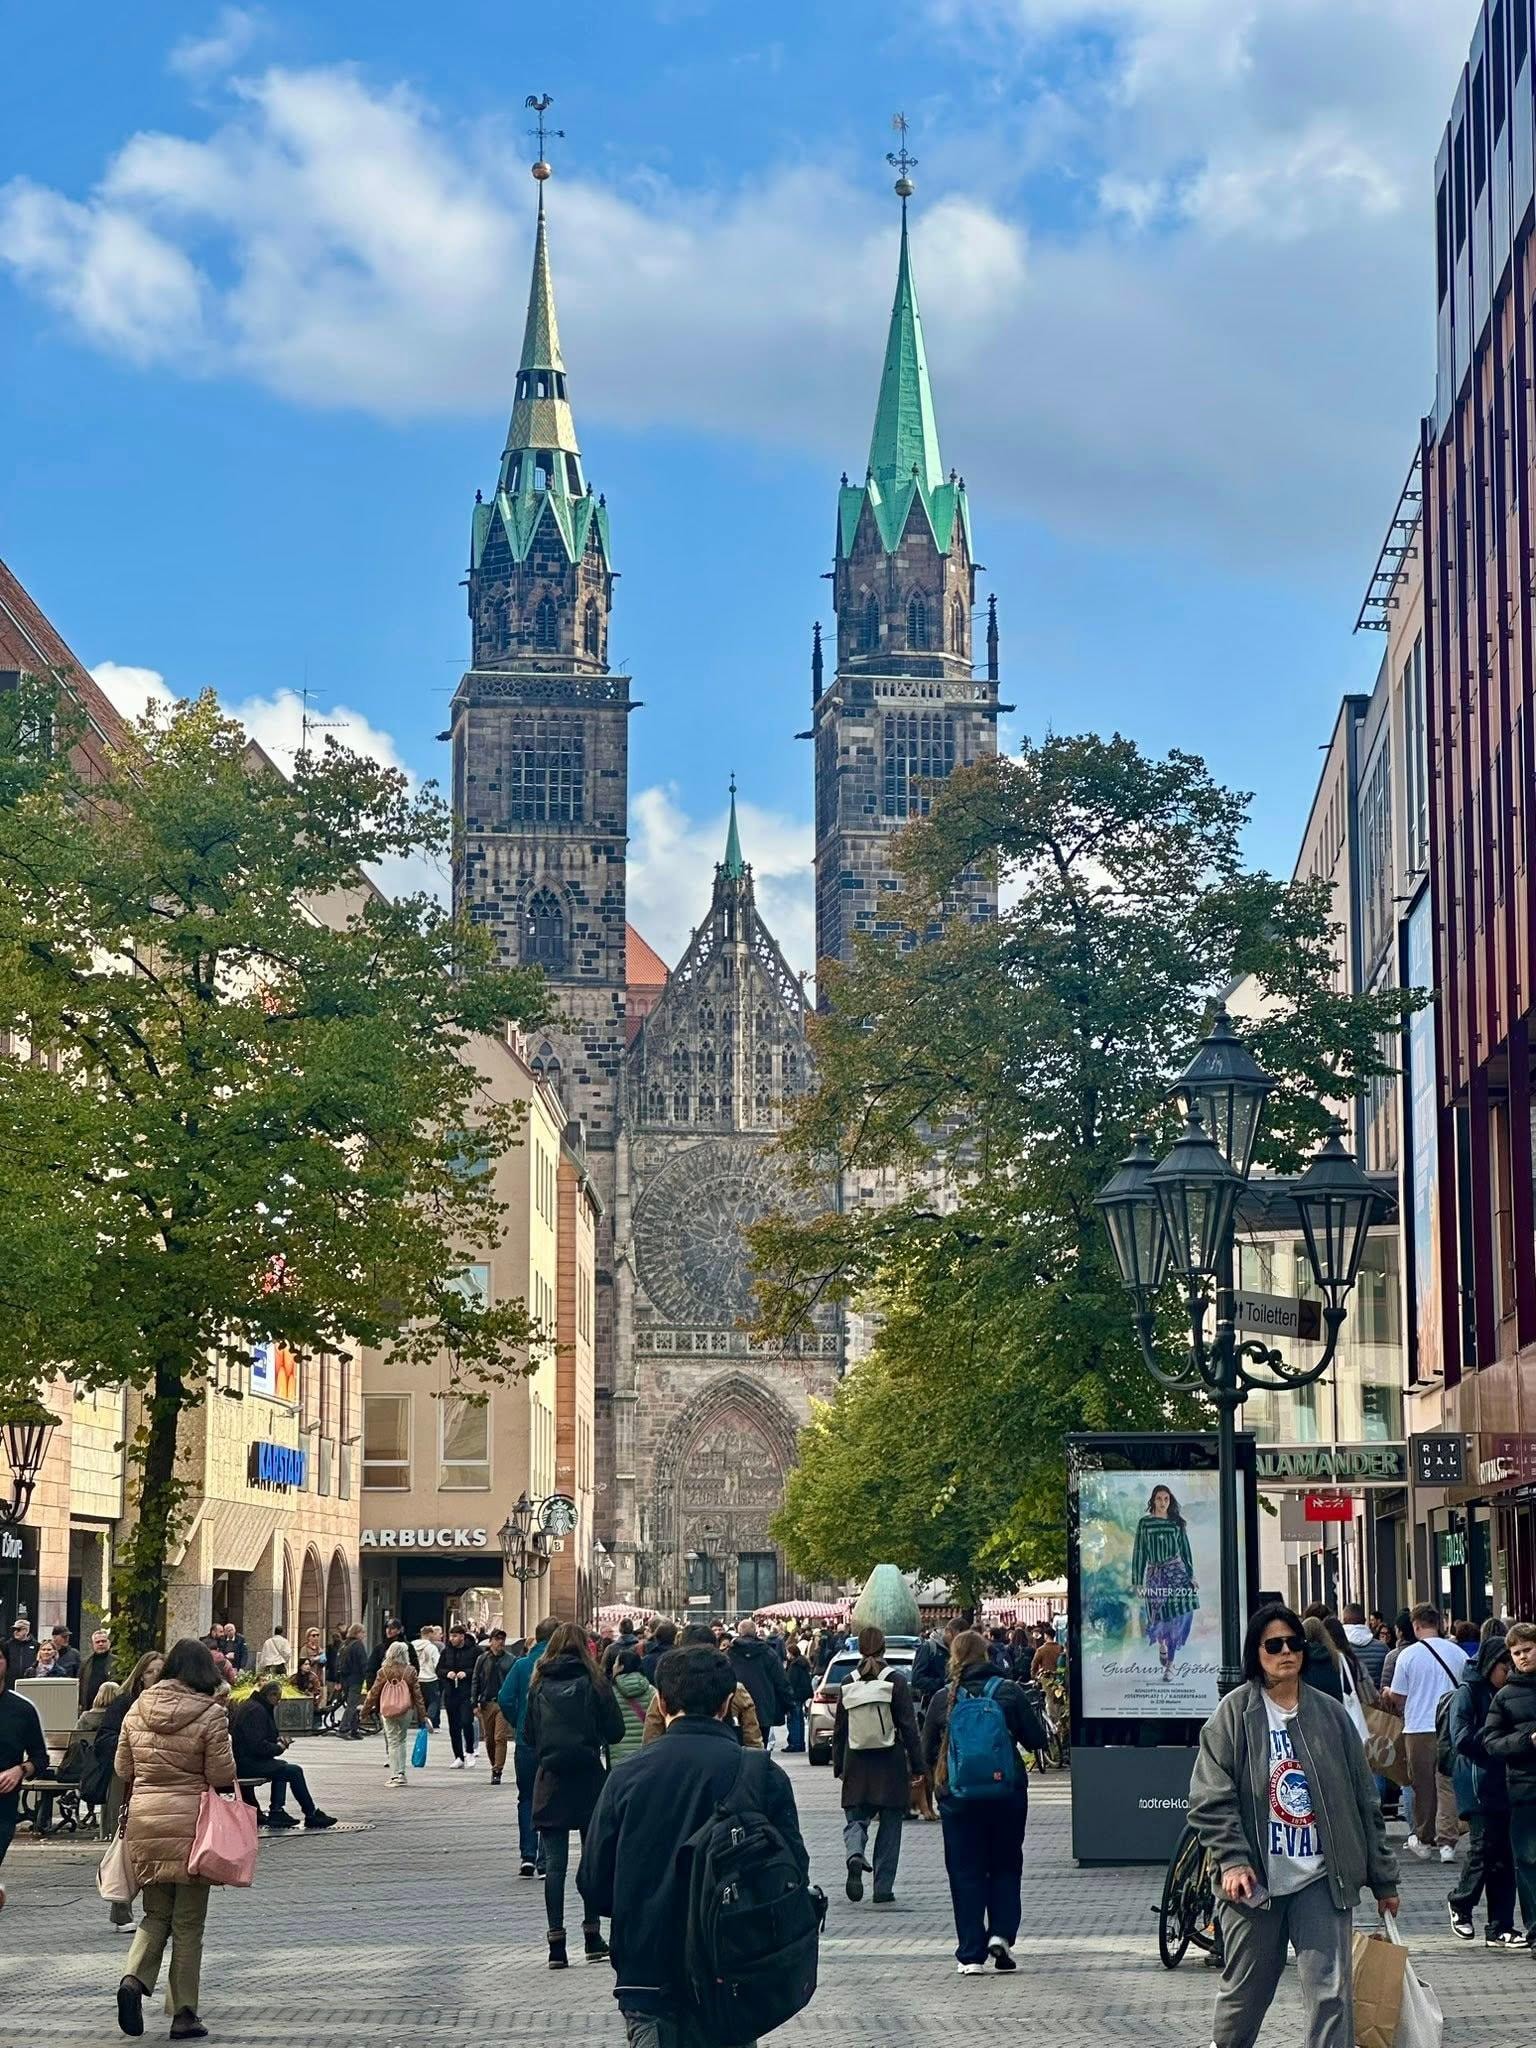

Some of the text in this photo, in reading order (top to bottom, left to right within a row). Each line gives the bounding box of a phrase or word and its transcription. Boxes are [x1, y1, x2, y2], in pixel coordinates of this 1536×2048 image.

[1246, 1302, 1297, 1327] Toiletten
[1423, 1444, 1455, 1452] RIT
[258, 1442, 305, 1487] KARSTADT
[1256, 1451, 1399, 1476] ALAMANDER
[1424, 1457, 1456, 1465] UAL
[360, 1528, 487, 1547] ARBUCKS
[1138, 1587, 1173, 1597] WINTER
[1101, 1662, 1163, 1677] Gudrun
[1270, 1764, 1286, 1808] UNIVERSITY
[1270, 1822, 1324, 1858] EVA
